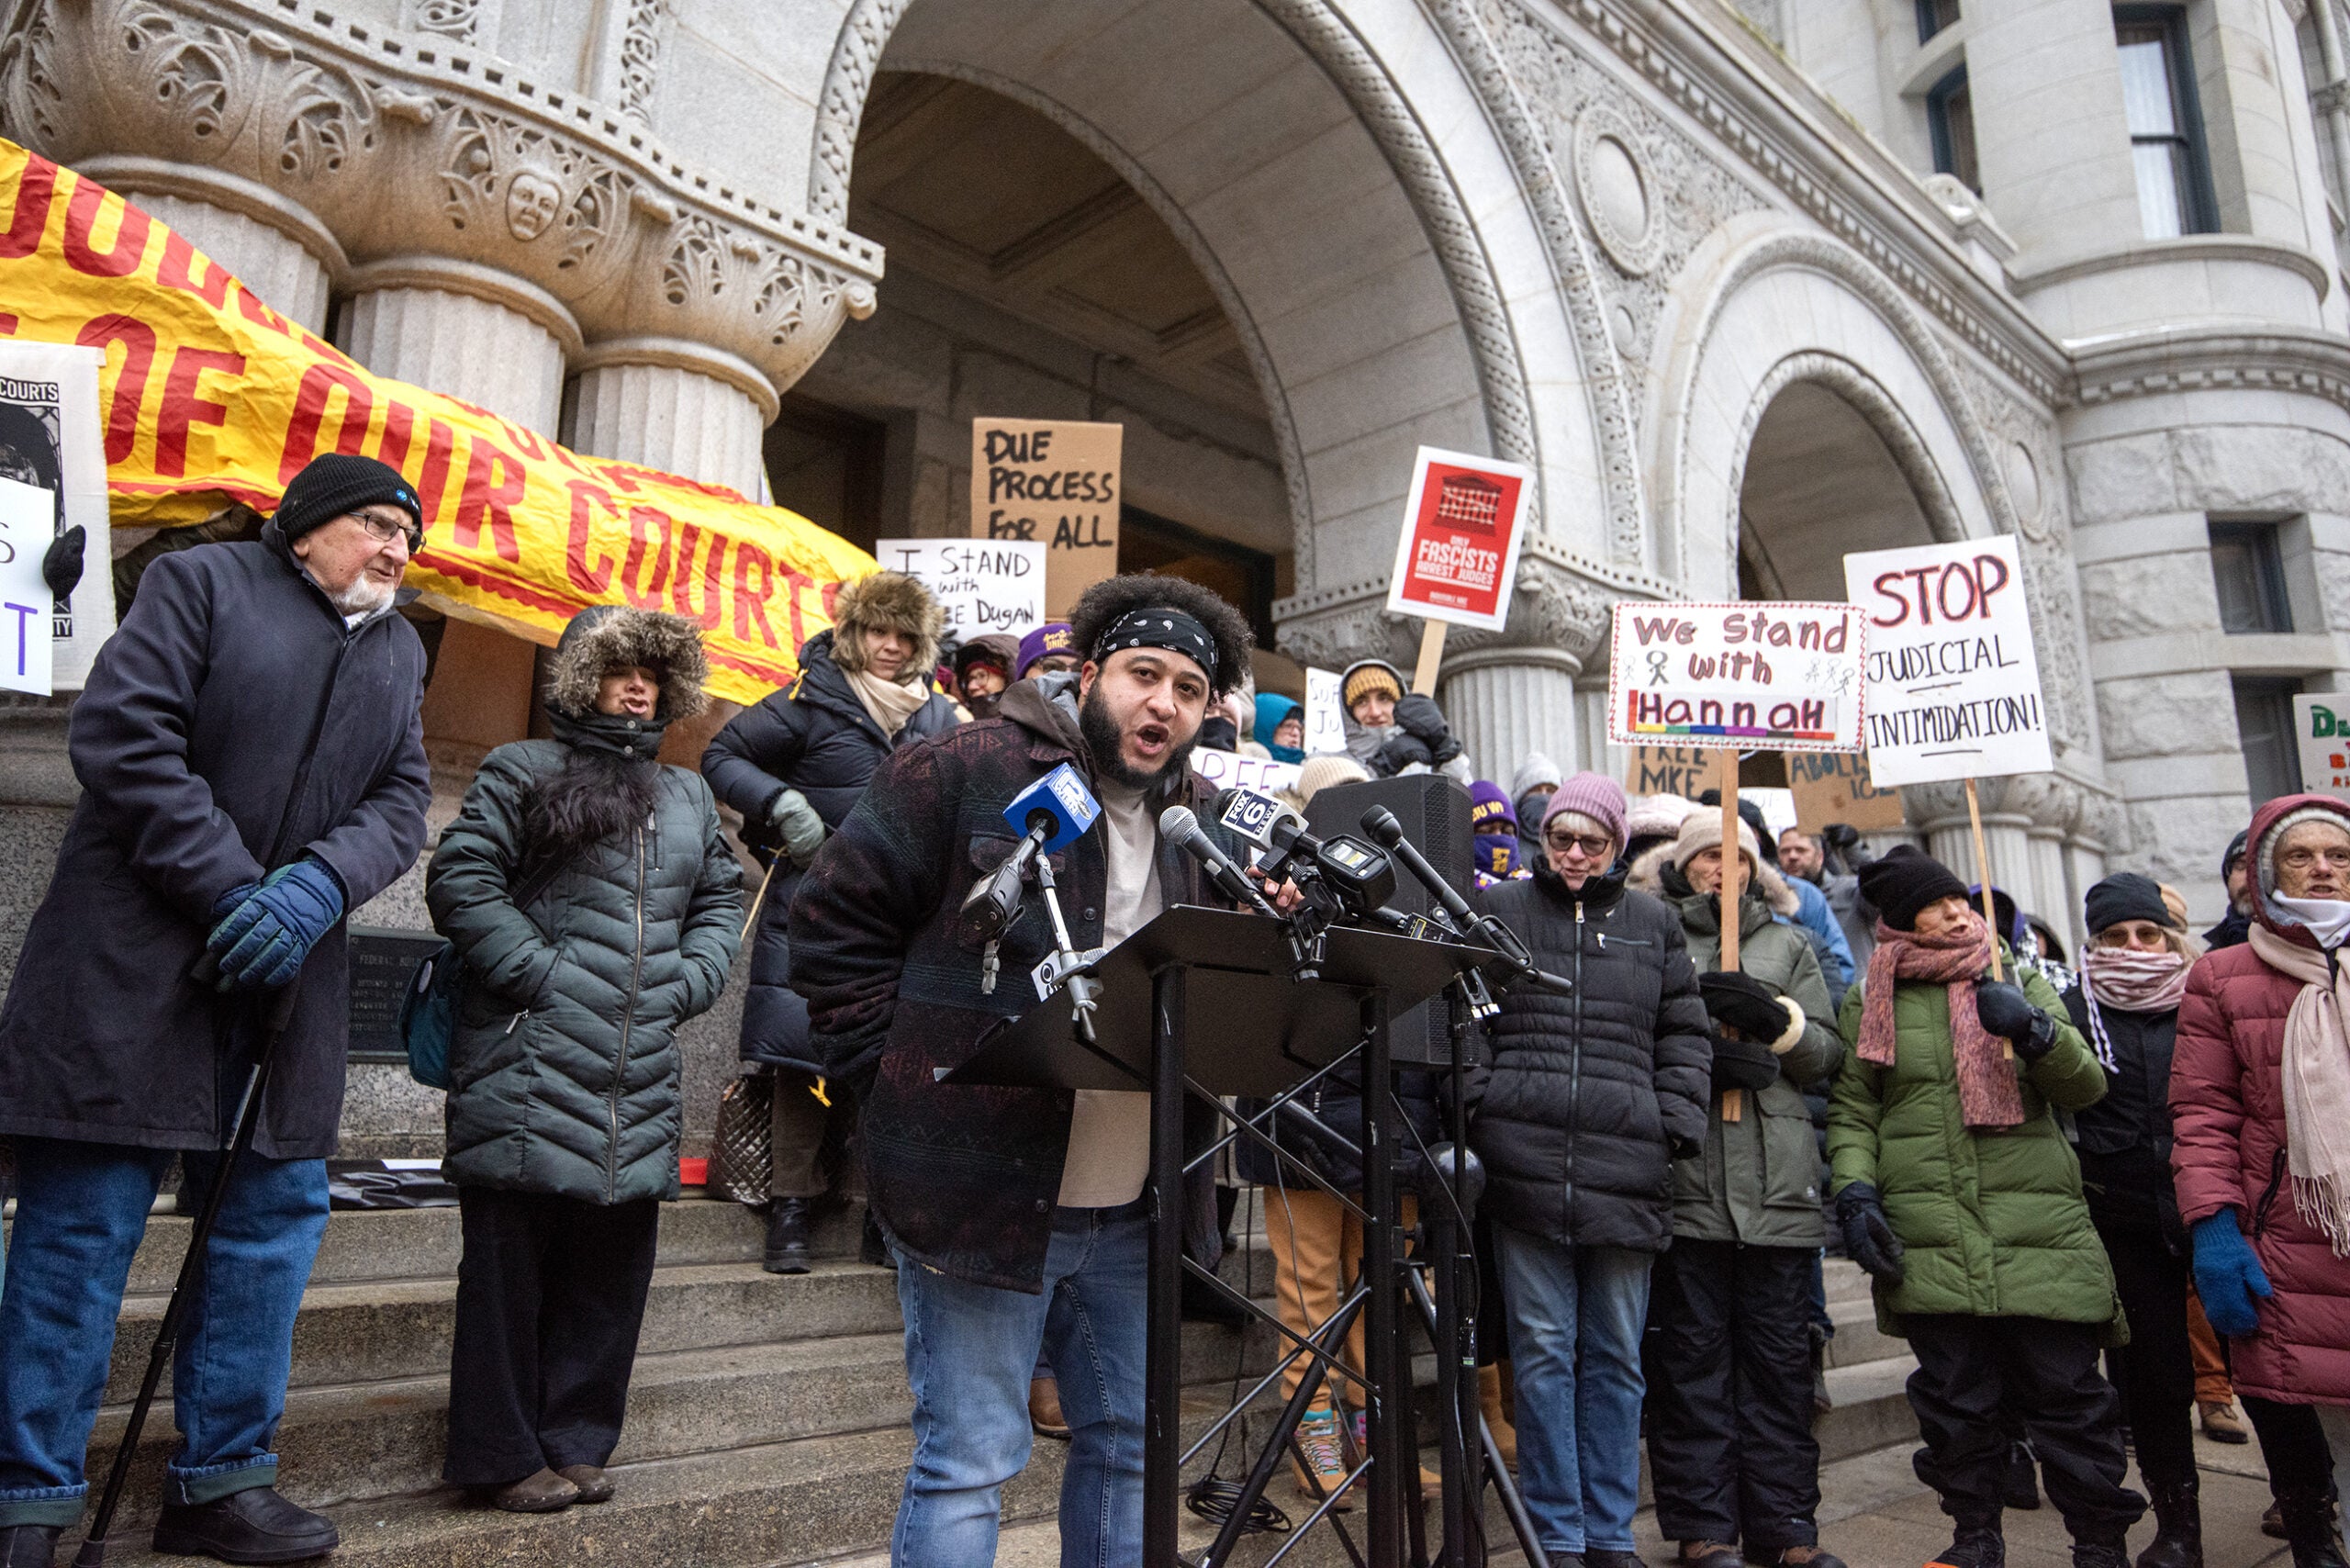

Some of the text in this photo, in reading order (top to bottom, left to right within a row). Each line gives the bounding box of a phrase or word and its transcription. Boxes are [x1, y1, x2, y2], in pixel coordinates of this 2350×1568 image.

[0, 378, 58, 400] COURTS
[75, 314, 247, 477] OF
[277, 364, 526, 564] OUR
[983, 430, 1052, 465] DUE
[989, 466, 1113, 504] PROCESS
[1052, 515, 1113, 550] ALL
[896, 549, 922, 575] I
[1417, 539, 1499, 574] FASCISTS
[939, 577, 979, 593] with
[1870, 554, 2010, 628] STOP
[1689, 651, 1772, 685] with
[1867, 634, 2020, 683] JUDICIAL
[1868, 694, 2041, 748] INTIMIDATION!
[1639, 764, 1703, 801] MKE
[1792, 751, 1870, 783] ABOLIS
[1228, 793, 1250, 820] FOX
[1243, 801, 1266, 824] 6
[1254, 801, 1279, 835] NEWS
